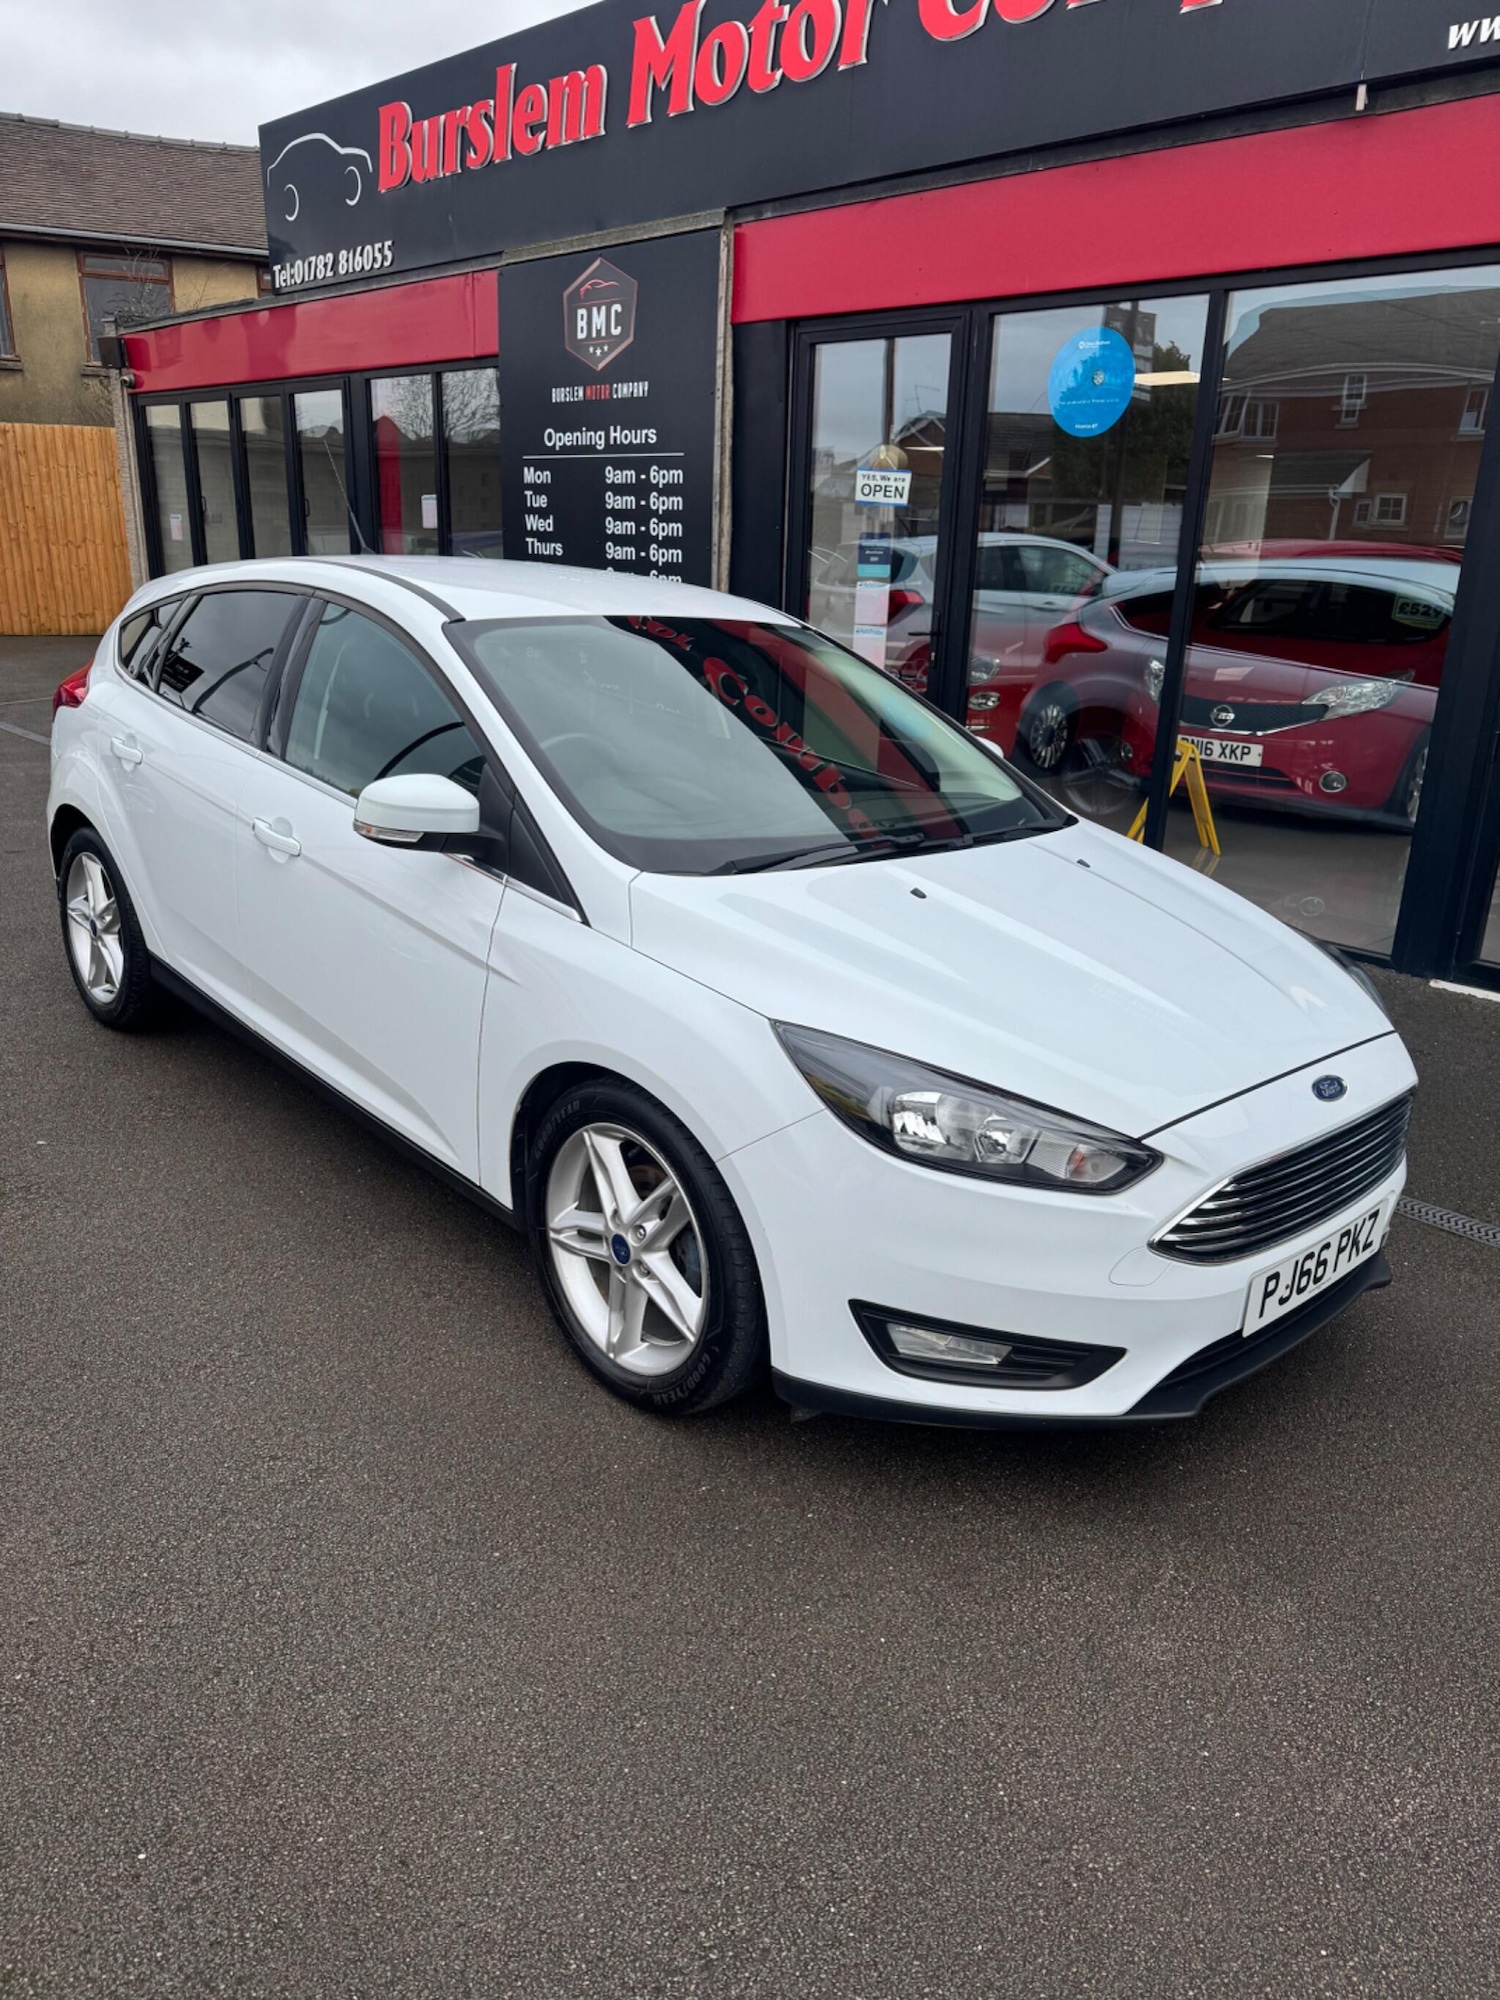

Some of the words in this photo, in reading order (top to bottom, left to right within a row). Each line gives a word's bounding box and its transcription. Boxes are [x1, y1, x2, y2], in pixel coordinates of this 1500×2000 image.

[378, 62, 607, 193] Burslem
[626, 0, 888, 128] Motor
[273, 253, 334, 288] Tel:01782
[339, 241, 393, 275] 816055
[576, 303, 622, 340] BMC
[552, 386, 584, 403] BURSLEM
[585, 384, 610, 400] MOTOR
[612, 381, 649, 399] COMPANY
[544, 427, 605, 451] Opening
[610, 426, 657, 444] Hours
[524, 467, 551, 484] Mon
[605, 466, 636, 484] 9am
[650, 465, 683, 488] 6pm
[524, 491, 548, 508] Tue
[605, 491, 636, 509] 9am
[650, 492, 683, 514] 6pm
[861, 484, 905, 499] OPEN
[525, 514, 553, 531] Wed
[605, 517, 636, 535] 9am
[650, 518, 682, 540] 6pm
[526, 537, 563, 556] Thurs
[605, 542, 636, 560] 9am
[650, 544, 682, 566] 6pm
[1218, 743, 1252, 762] XKP
[1258, 1240, 1332, 1319] PJ66
[1332, 1207, 1380, 1274] PKZ
